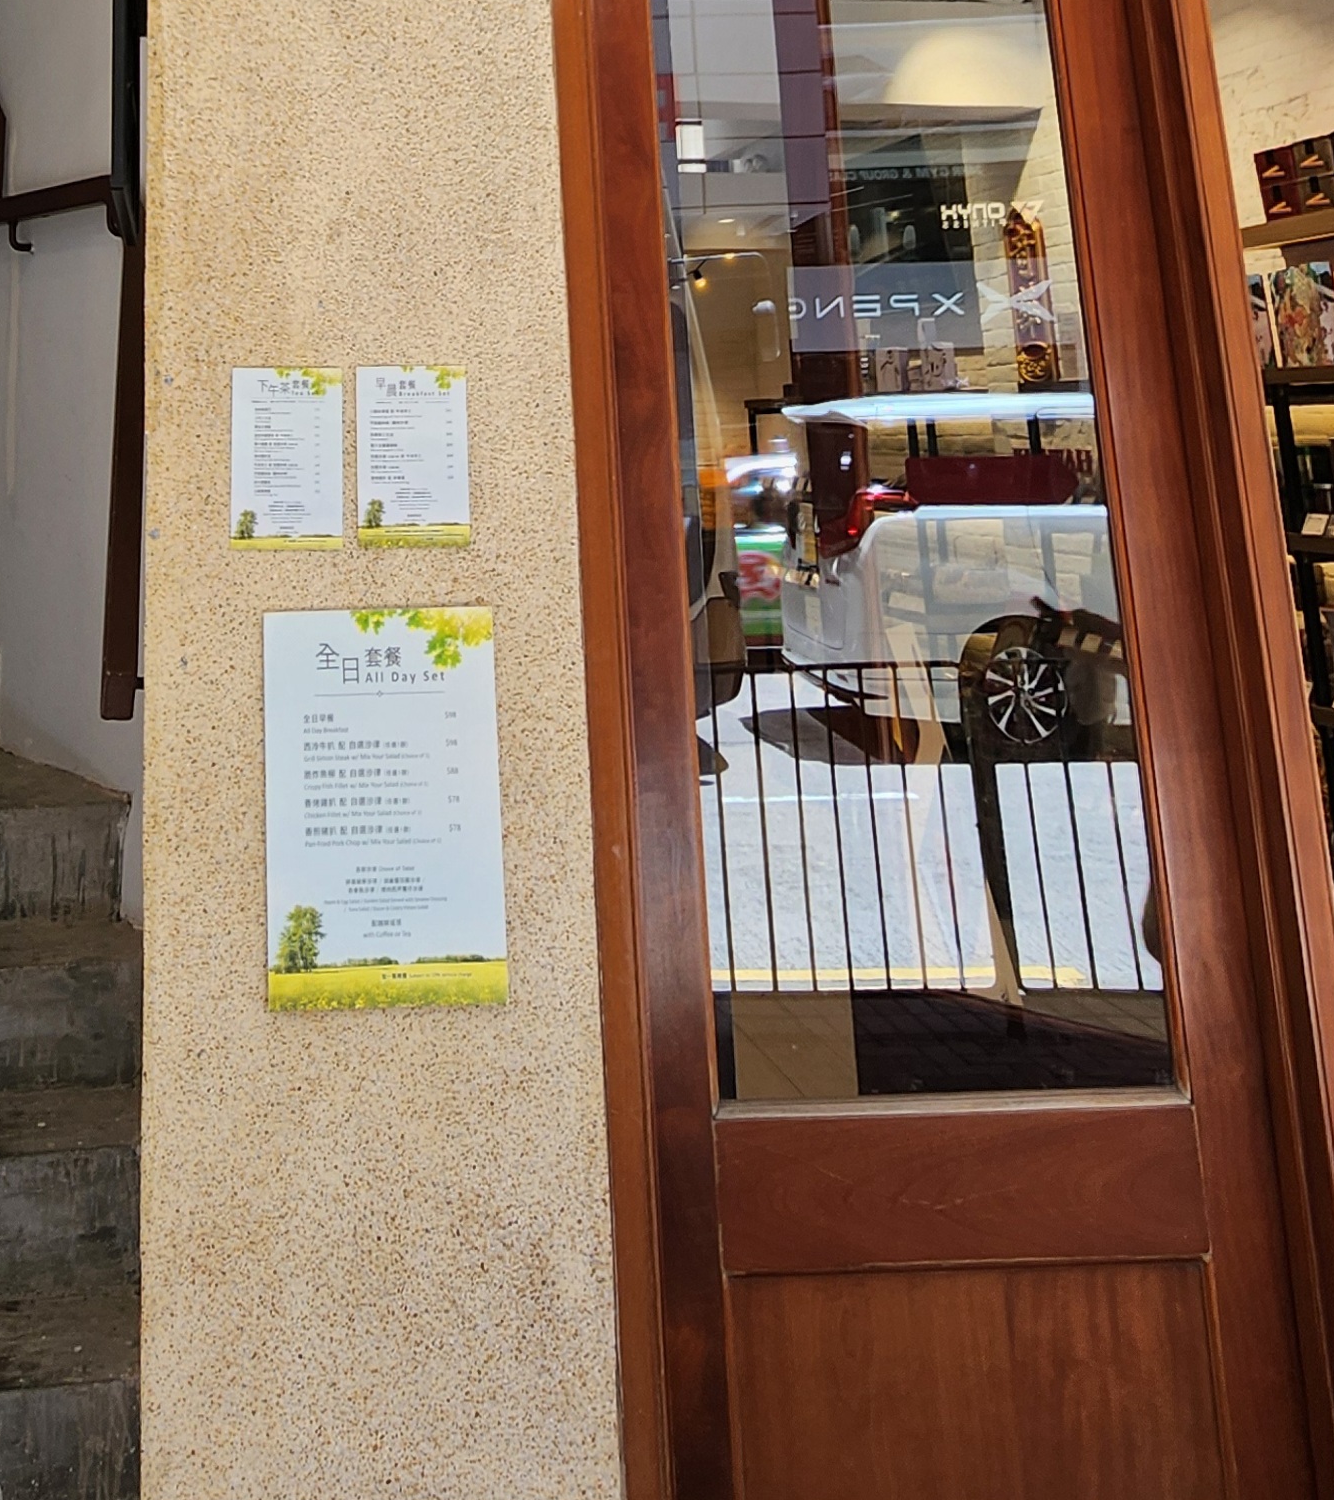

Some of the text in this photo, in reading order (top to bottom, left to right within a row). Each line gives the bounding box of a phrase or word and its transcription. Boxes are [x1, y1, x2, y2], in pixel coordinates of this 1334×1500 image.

[315, 643, 402, 684] 全日套餐
[364, 670, 445, 684] All Day Set
[338, 741, 346, 750] 配
[339, 769, 347, 779] 配
[339, 797, 347, 807] 配
[340, 825, 348, 835] 配
